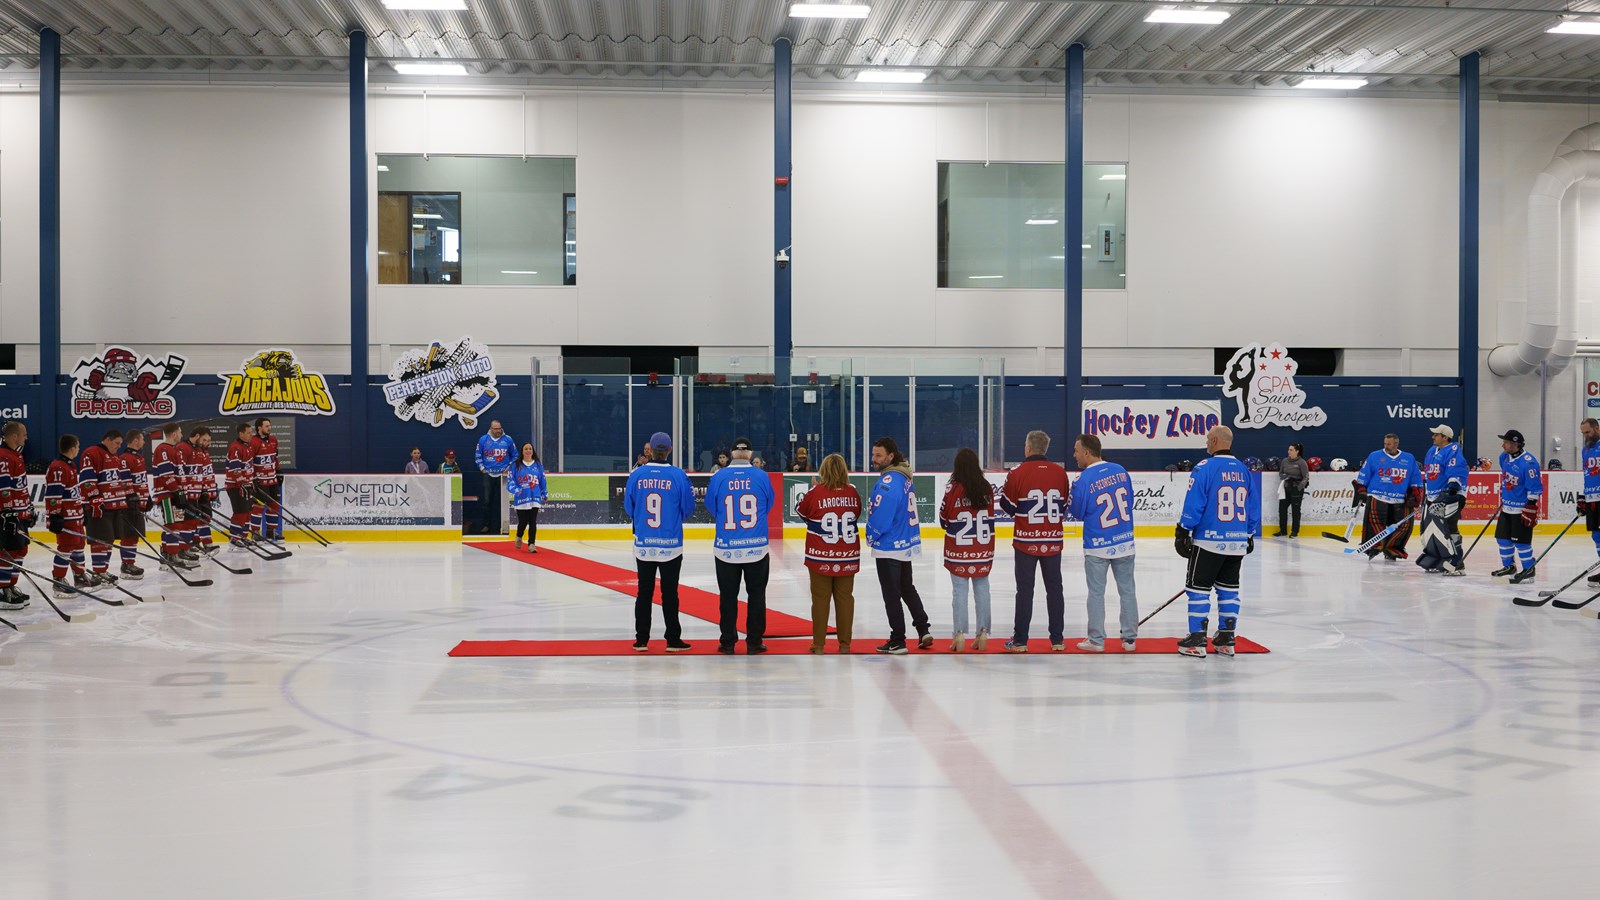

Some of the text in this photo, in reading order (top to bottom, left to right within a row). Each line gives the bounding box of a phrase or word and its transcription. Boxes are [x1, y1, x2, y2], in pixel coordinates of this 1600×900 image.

[387, 356, 492, 401] PERFECTION AUTO
[1257, 376, 1293, 393] CPA
[221, 374, 332, 412] CARCAJOUS
[1252, 388, 1301, 406] Saint
[1254, 406, 1322, 426] Prosper
[1386, 403, 1451, 418] Visiteur
[1084, 406, 1219, 439] Hockey Zone
[260, 455, 272, 465] 24
[53, 470, 63, 481] 17
[106, 471, 119, 481] 24
[1222, 471, 1244, 483] MAGILL
[1378, 467, 1408, 479] 24DH
[324, 480, 408, 498] JONCTION
[637, 479, 672, 491] FORTIER
[728, 477, 751, 491] CÔTÉ
[818, 496, 859, 510] LAROCHELLE
[875, 494, 883, 507] 9
[908, 491, 920, 527] 9
[1027, 489, 1061, 525] 26
[1217, 485, 1248, 523] 89
[646, 492, 663, 529] 9
[724, 494, 758, 530] 19
[821, 511, 857, 545] 96
[956, 510, 991, 546] 26
